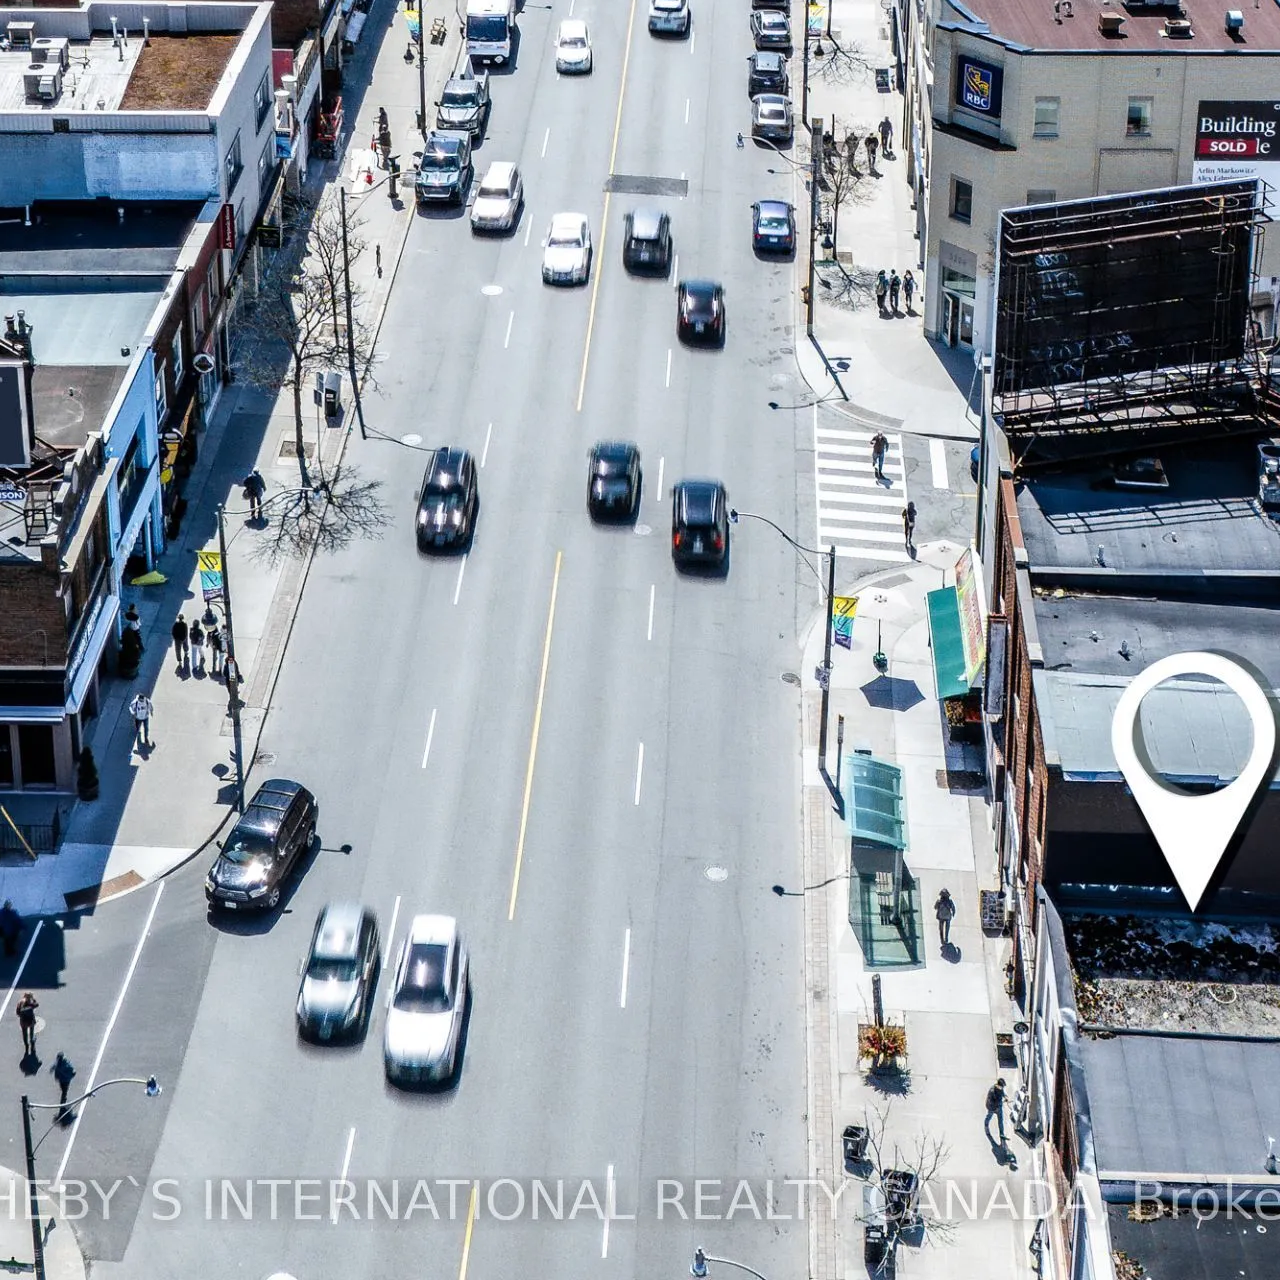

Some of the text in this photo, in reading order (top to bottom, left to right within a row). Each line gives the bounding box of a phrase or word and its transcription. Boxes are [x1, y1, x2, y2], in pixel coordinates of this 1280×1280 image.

[966, 92, 988, 108] RBC
[1200, 117, 1277, 137] Building
[1210, 141, 1247, 153] SOLD
